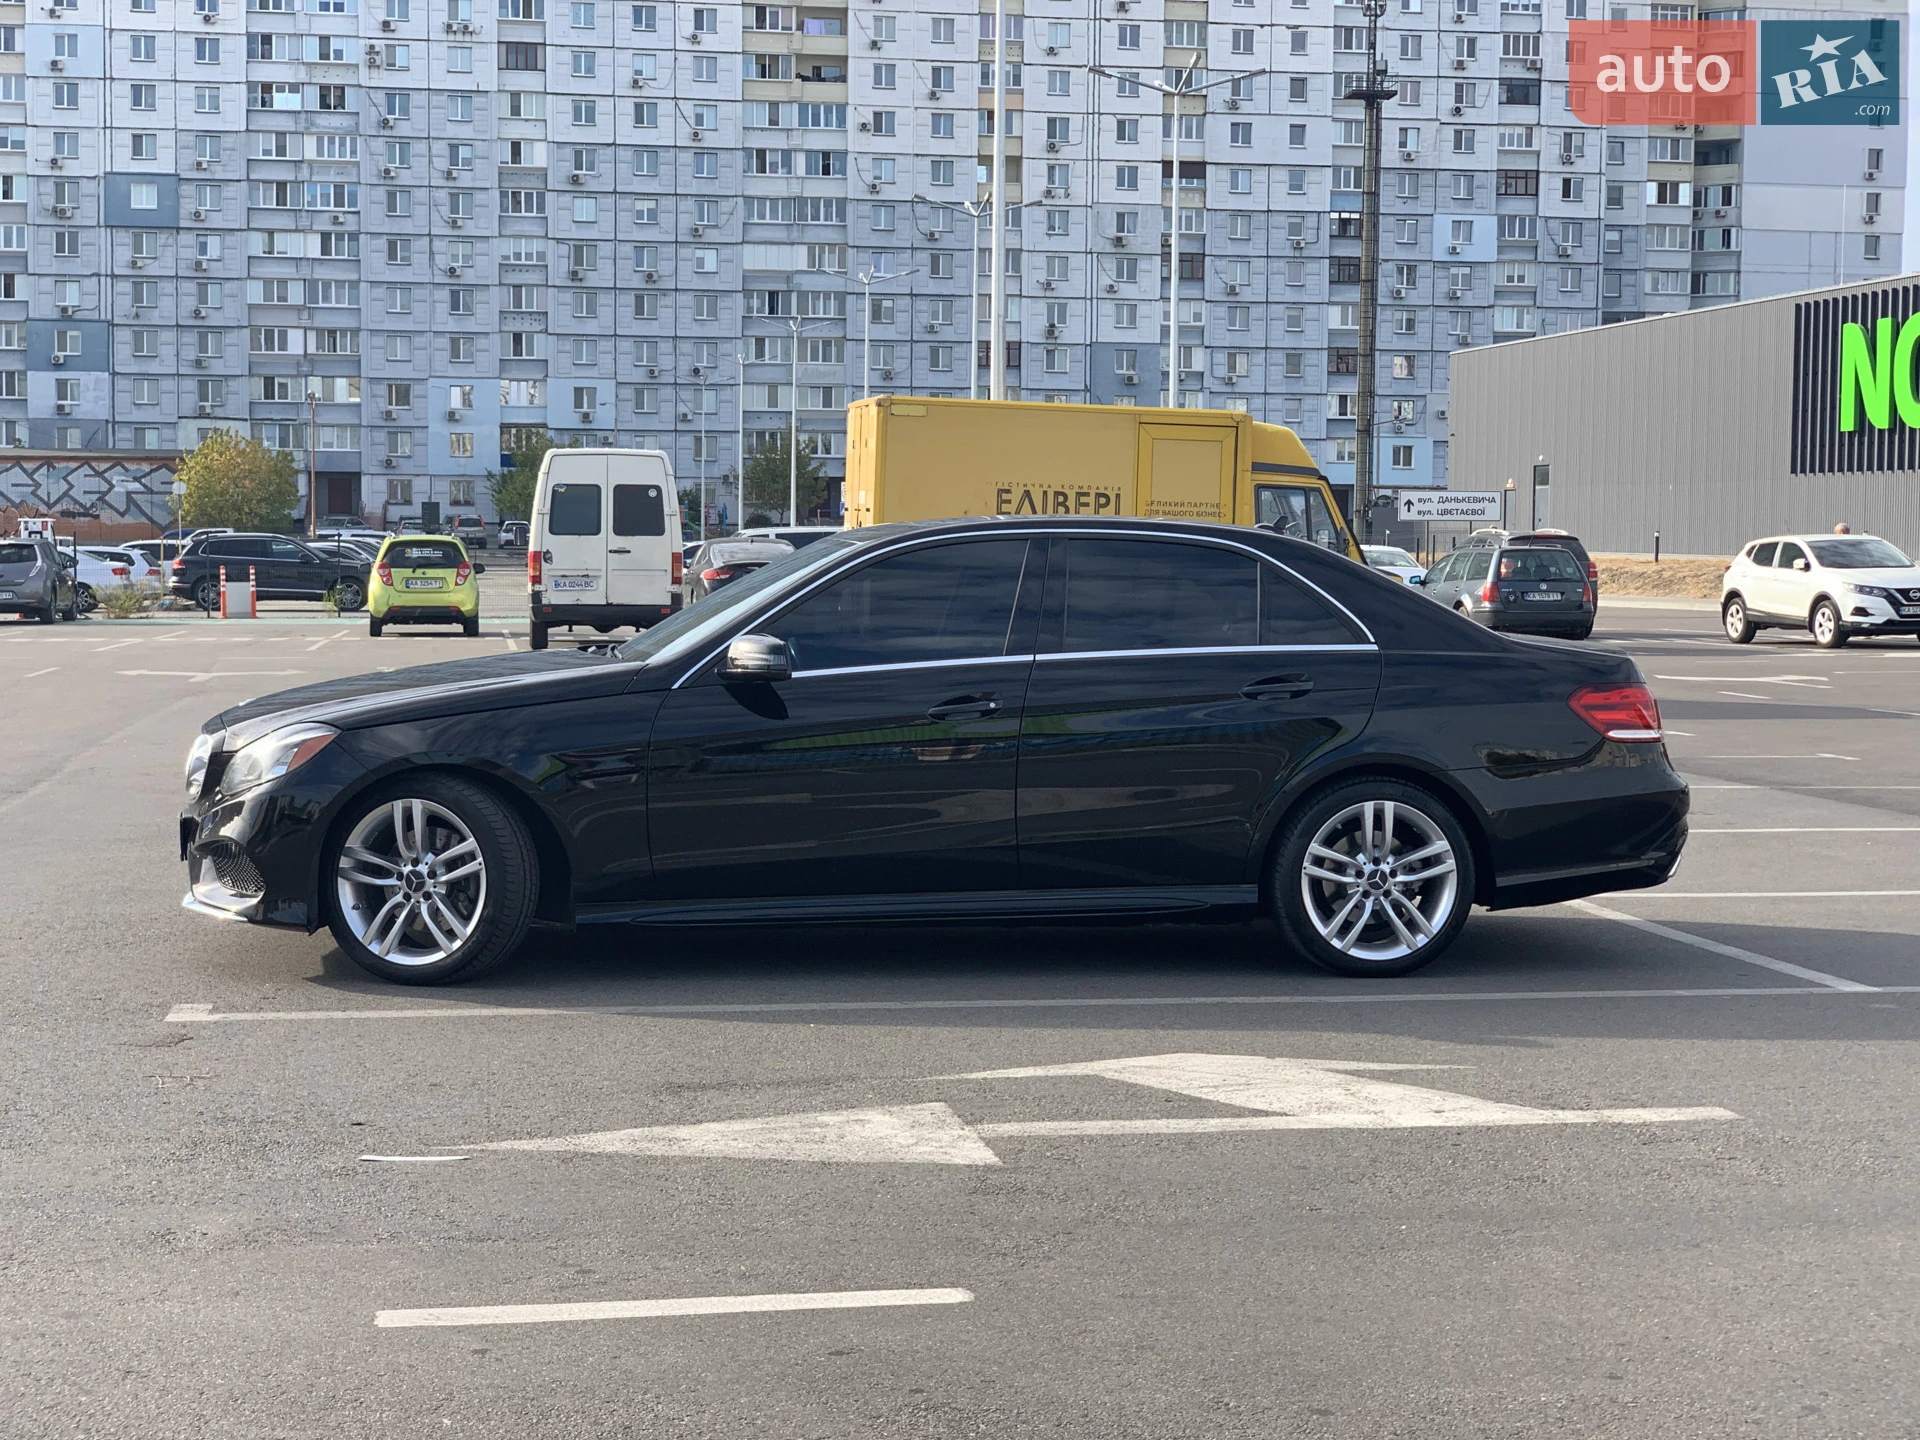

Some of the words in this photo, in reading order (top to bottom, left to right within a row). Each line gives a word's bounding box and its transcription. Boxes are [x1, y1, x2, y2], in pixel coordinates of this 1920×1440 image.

[986, 481, 1052, 489] ГІСТИЧНА
[1061, 484, 1122, 492] КОМПАНІЯ
[1437, 496, 1496, 504] ДАНЬКЕВИЧА
[1186, 501, 1227, 510] ПАРТНЕ
[1161, 509, 1194, 517] ВАШОГО
[1417, 509, 1434, 517] вул.
[1436, 508, 1485, 517] ЦВЄТАЄВОЇ
